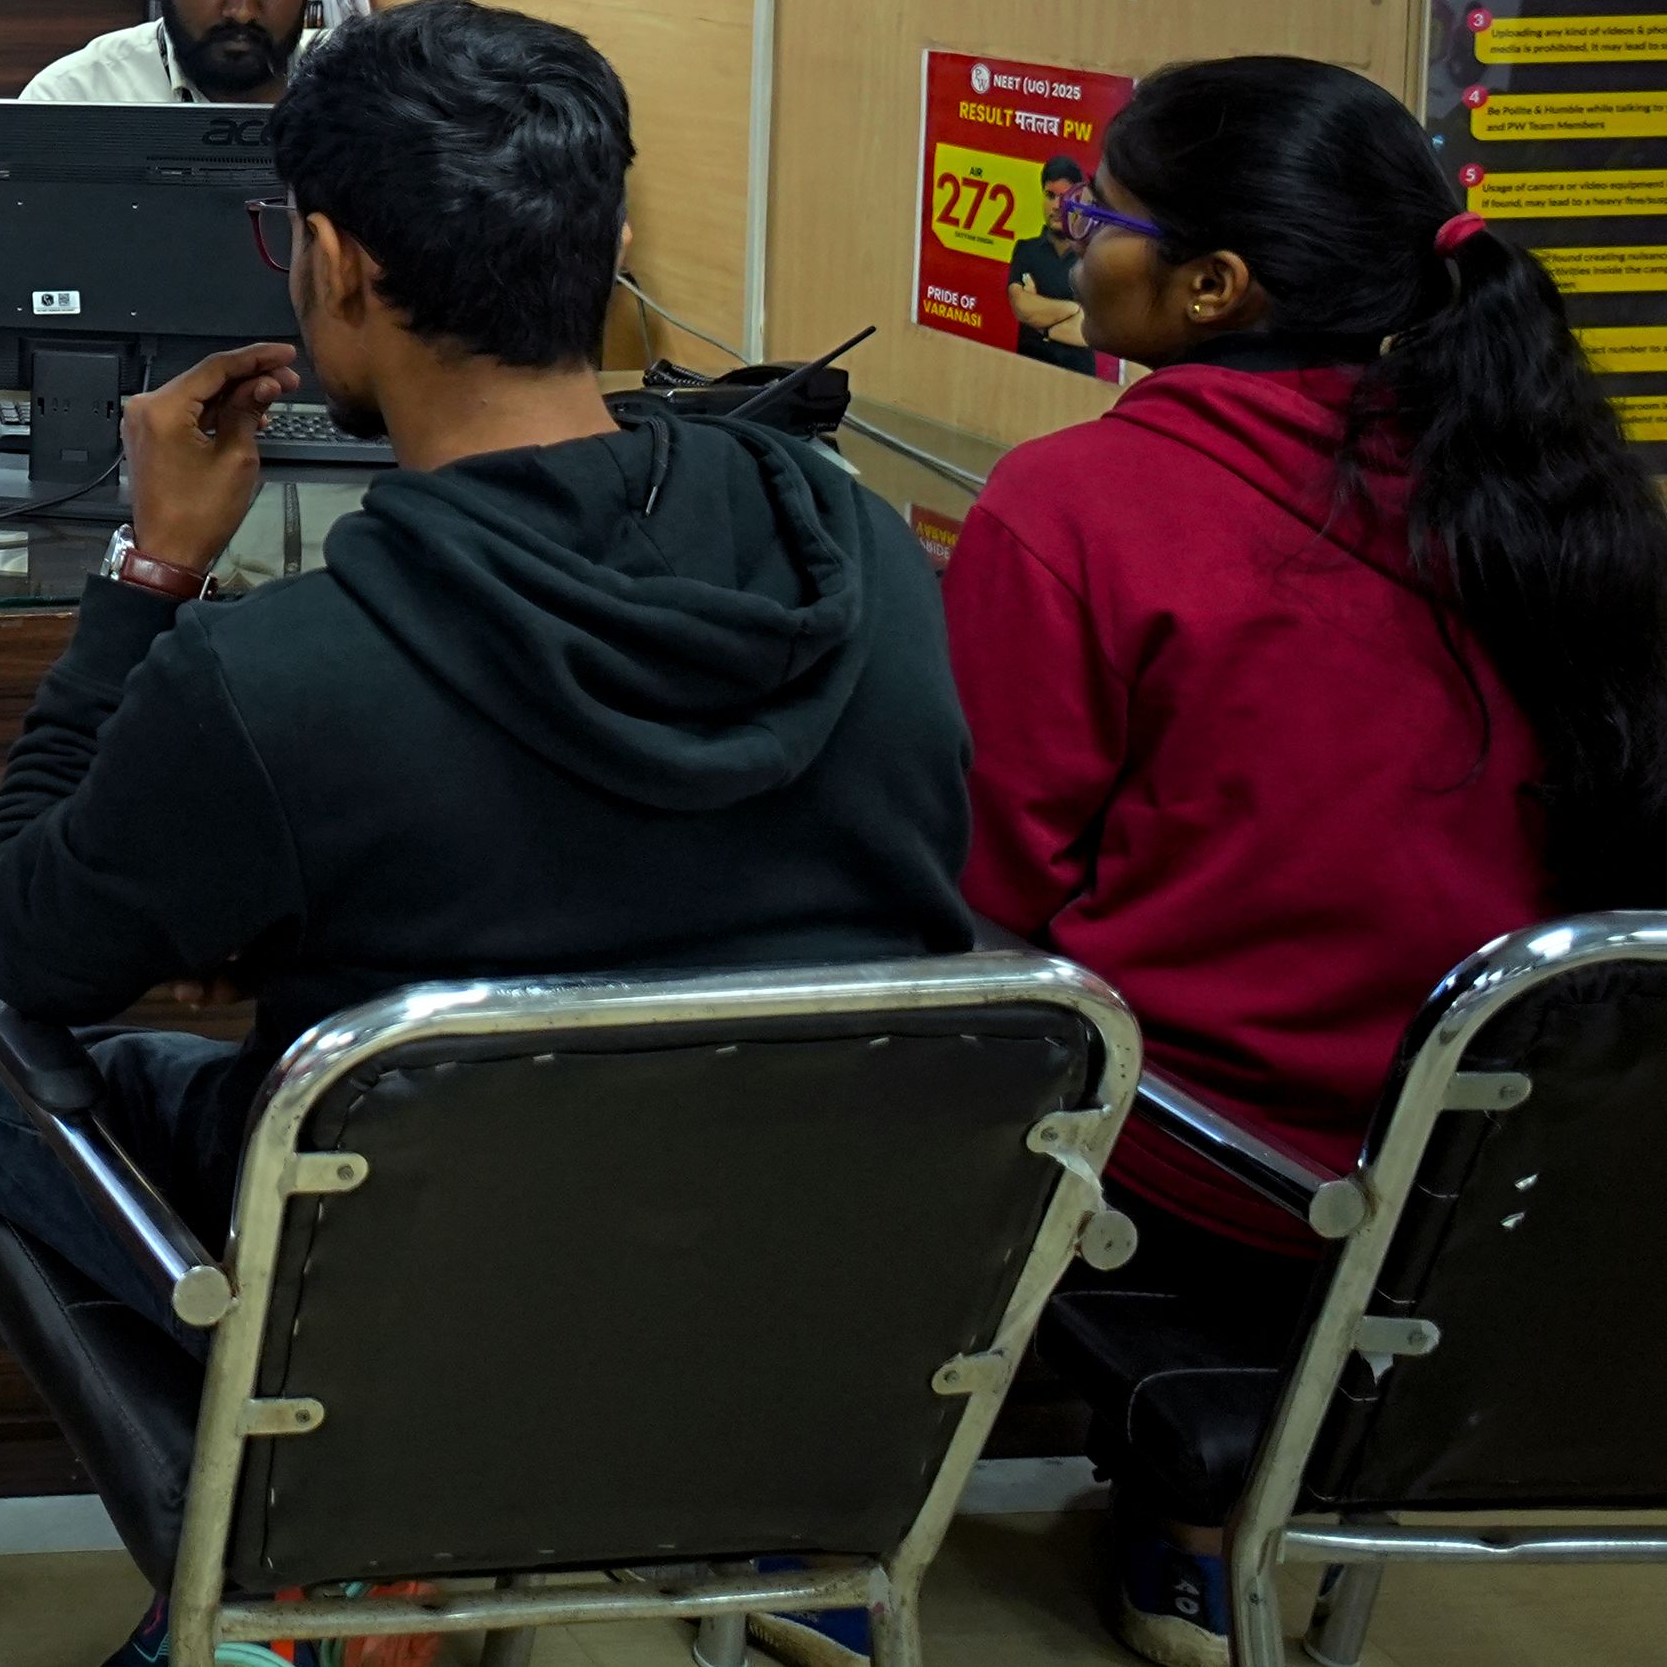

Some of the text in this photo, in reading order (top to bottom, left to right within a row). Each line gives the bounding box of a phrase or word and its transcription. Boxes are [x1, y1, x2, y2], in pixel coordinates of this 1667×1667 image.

[1473, 13, 1484, 27] 3
[993, 74, 1021, 91] NEET
[1023, 76, 1051, 99] (UG)
[1051, 82, 1082, 100] 2025
[1469, 90, 1480, 104] 4
[1545, 105, 1584, 115] Humble
[959, 100, 1093, 143] RESULT मतलब PW
[1529, 121, 1555, 130] Team
[1557, 120, 1605, 130] Members
[969, 166, 983, 178] AIR
[1465, 168, 1476, 181] 5
[1483, 183, 1513, 194] Usage
[1527, 183, 1565, 192] camera
[937, 172, 1015, 240] 272
[927, 286, 977, 310] PRIDE OF
[923, 299, 982, 328] VARANASI
